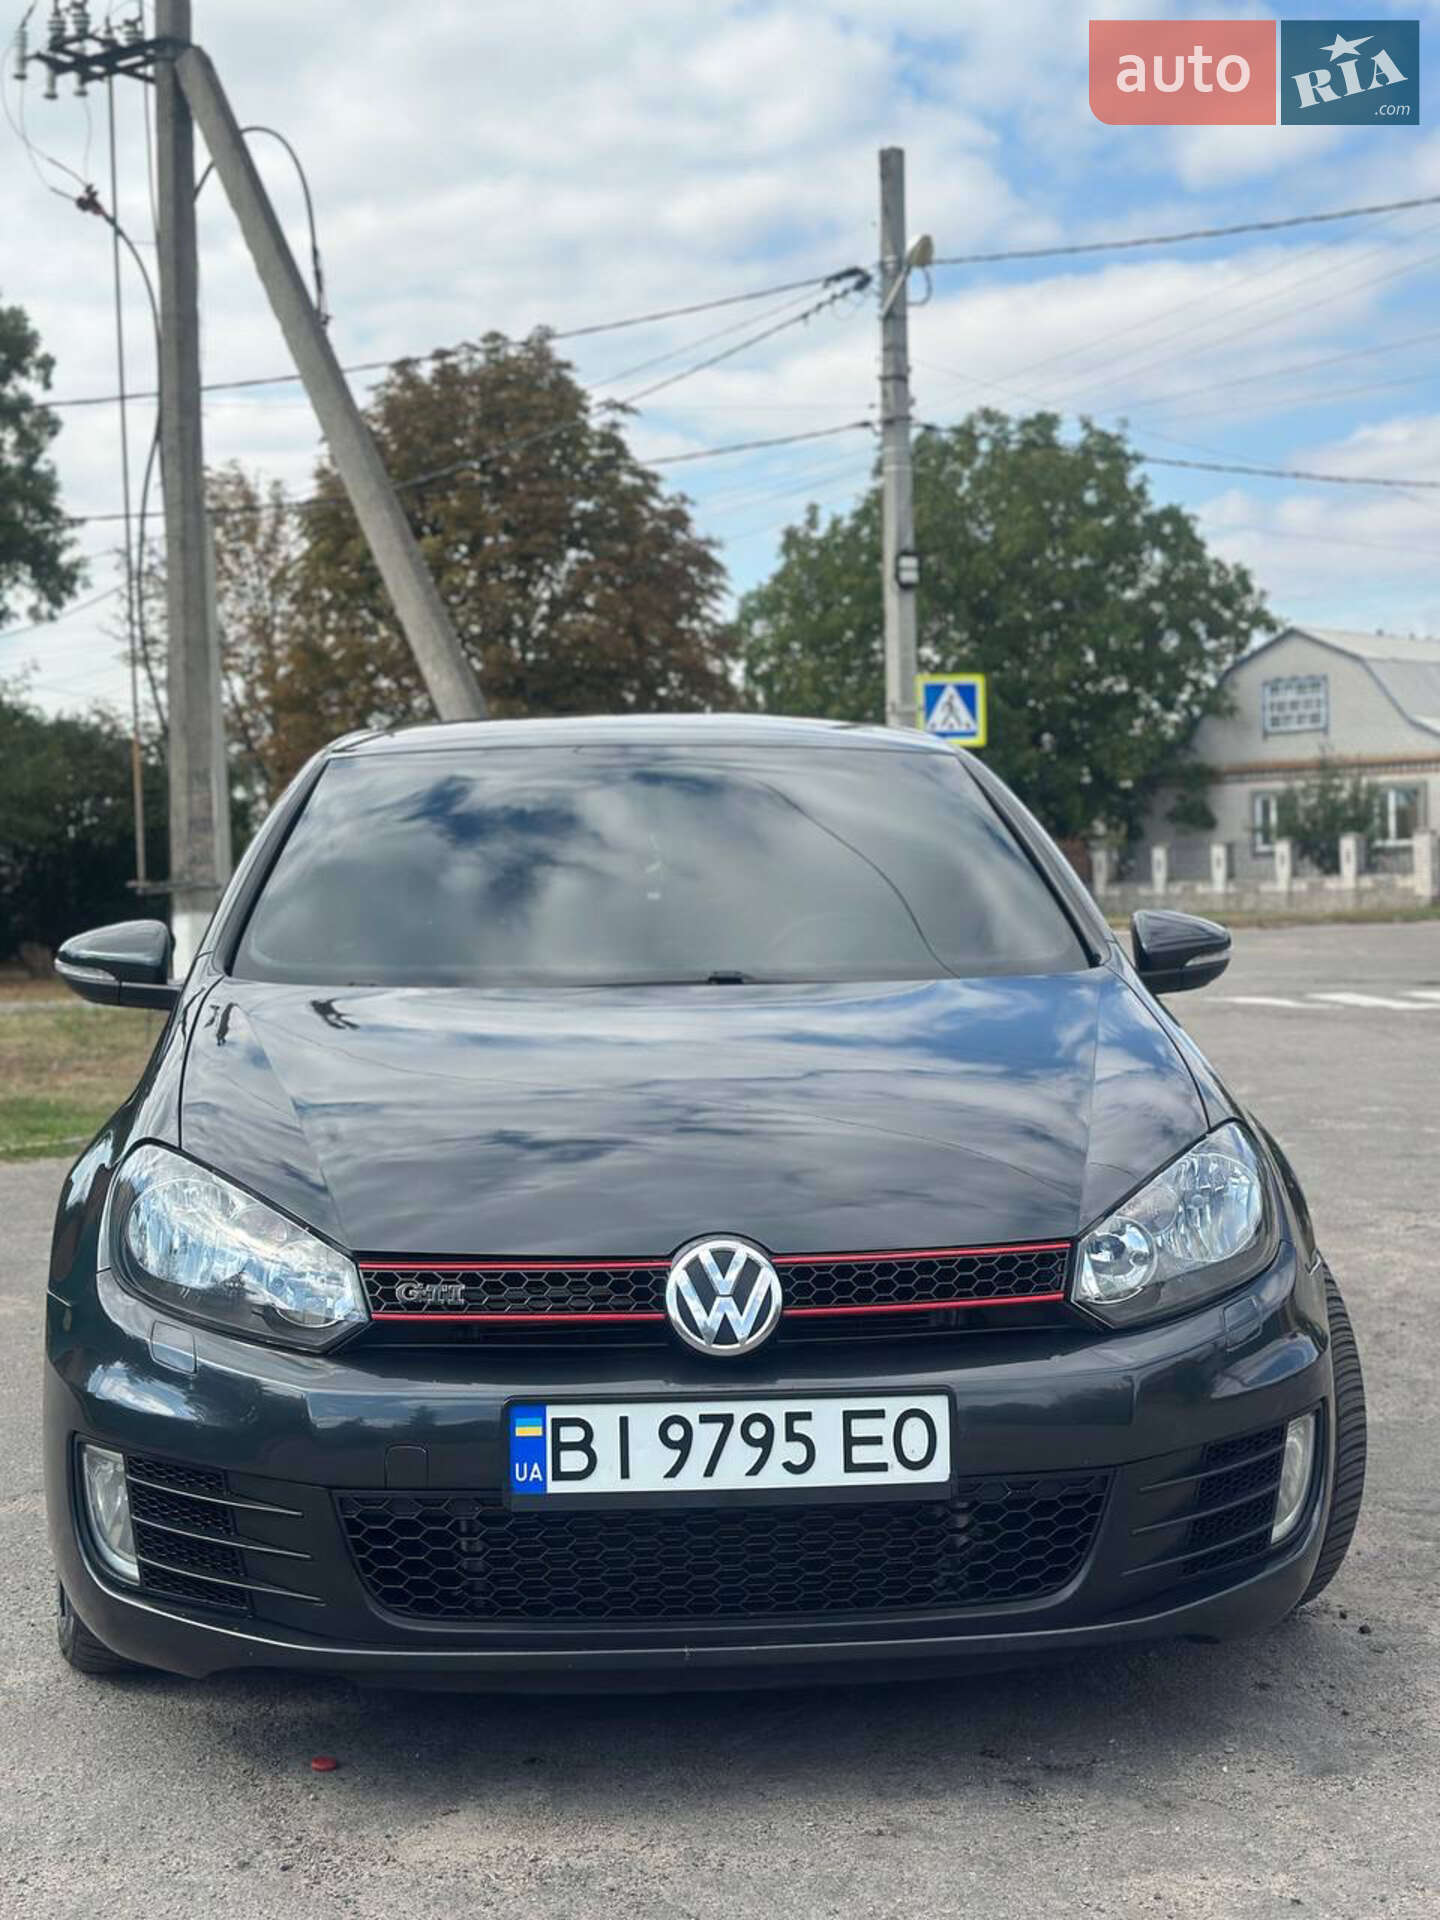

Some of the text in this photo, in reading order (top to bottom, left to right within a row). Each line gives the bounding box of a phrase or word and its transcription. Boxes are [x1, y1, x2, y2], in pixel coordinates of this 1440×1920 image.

[395, 1282, 466, 1305] GTI
[550, 1407, 938, 1482] BI 9795 EO
[515, 1462, 543, 1483] UA
